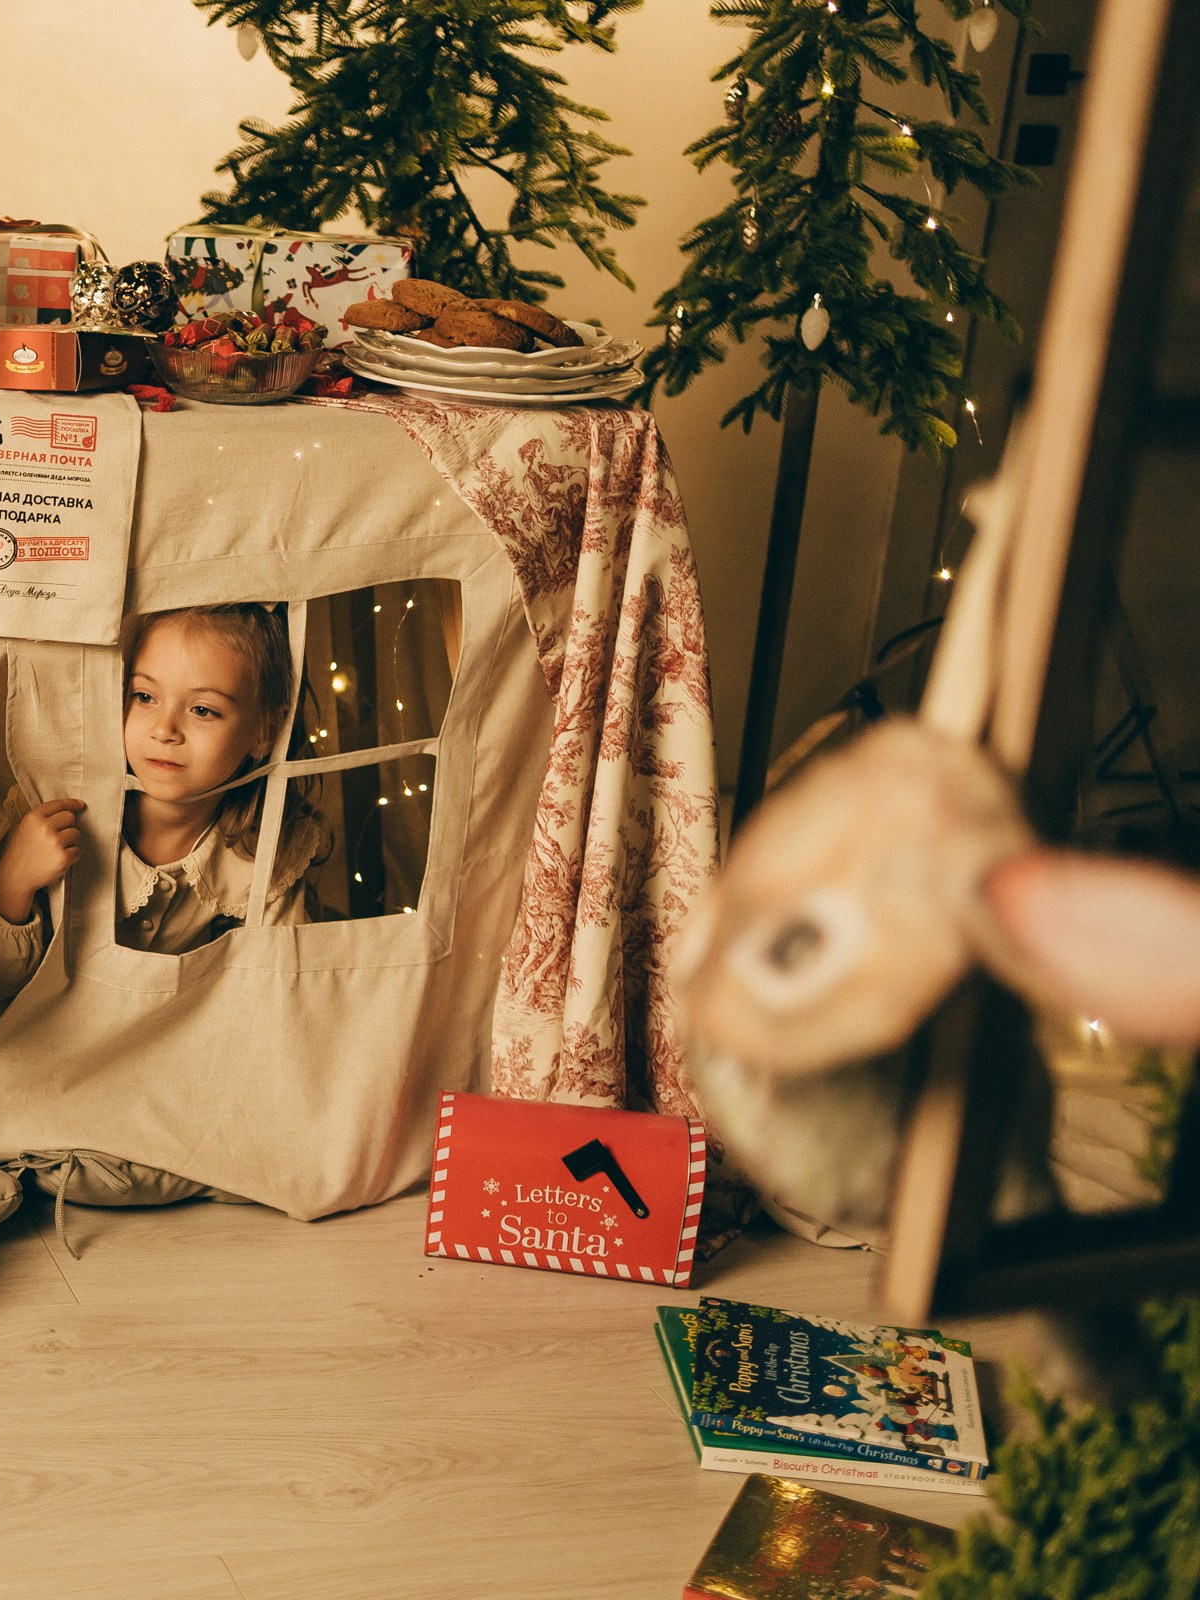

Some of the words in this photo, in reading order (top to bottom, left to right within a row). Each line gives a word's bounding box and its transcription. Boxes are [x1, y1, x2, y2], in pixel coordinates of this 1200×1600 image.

[49, 454, 93, 467] ПОЧТА
[22, 493, 93, 510] ДОСТАВКА
[18, 548, 26, 558] В
[29, 546, 85, 557] ПОЛНОЧЬ
[515, 1184, 603, 1213] Letters
[547, 1208, 568, 1225] to
[498, 1214, 609, 1257] Santa
[731, 1322, 754, 1350] Sam's
[737, 1348, 750, 1361] and
[763, 1343, 781, 1381] Lift-the-Flap
[776, 1330, 812, 1404] Christmas
[729, 1361, 759, 1393] Poppy
[731, 1419, 764, 1437] Poppy
[777, 1428, 805, 1442] Sam's
[857, 1444, 919, 1466] Christmas
[773, 1459, 819, 1474] Biscuit's
[821, 1463, 879, 1479] Christmas
[884, 1473, 935, 1482] STORYBOOK
